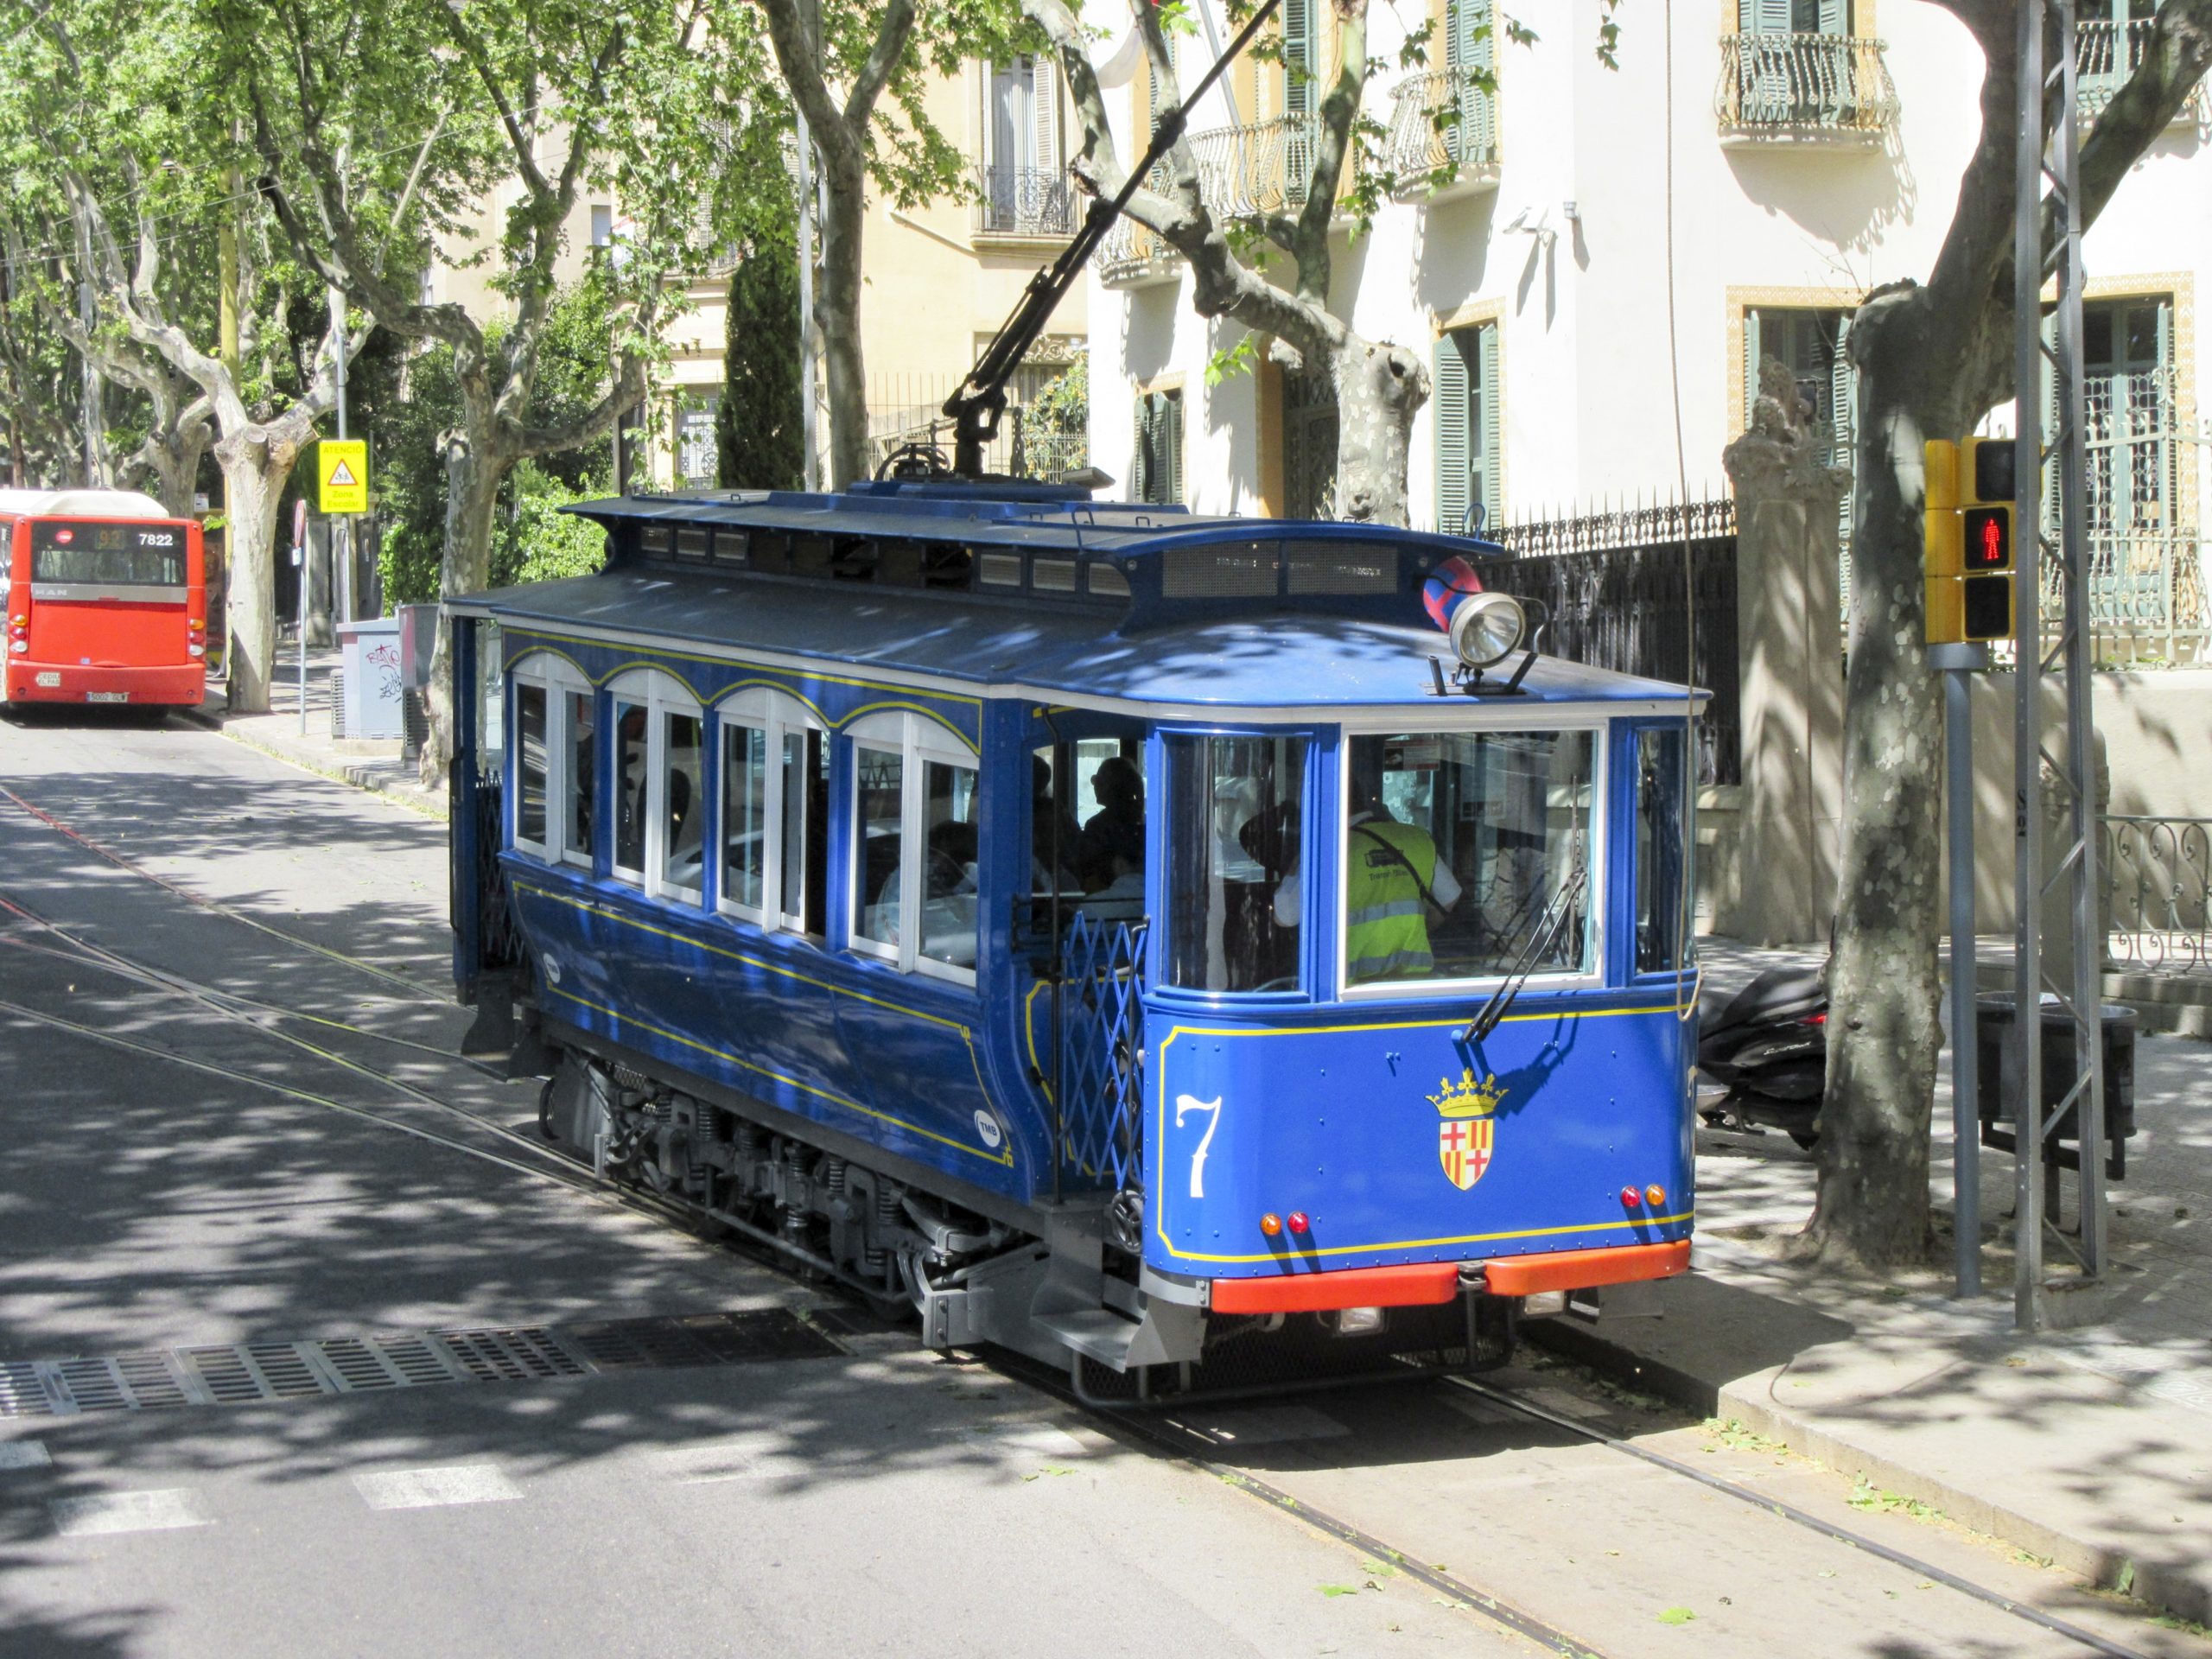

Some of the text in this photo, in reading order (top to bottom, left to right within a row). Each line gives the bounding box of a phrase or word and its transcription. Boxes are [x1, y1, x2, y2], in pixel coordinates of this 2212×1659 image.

[323, 445, 363, 454] ATENCIÓ
[138, 534, 174, 546] 7822
[979, 1122, 998, 1136] TMB
[1175, 1094, 1223, 1198] 7
